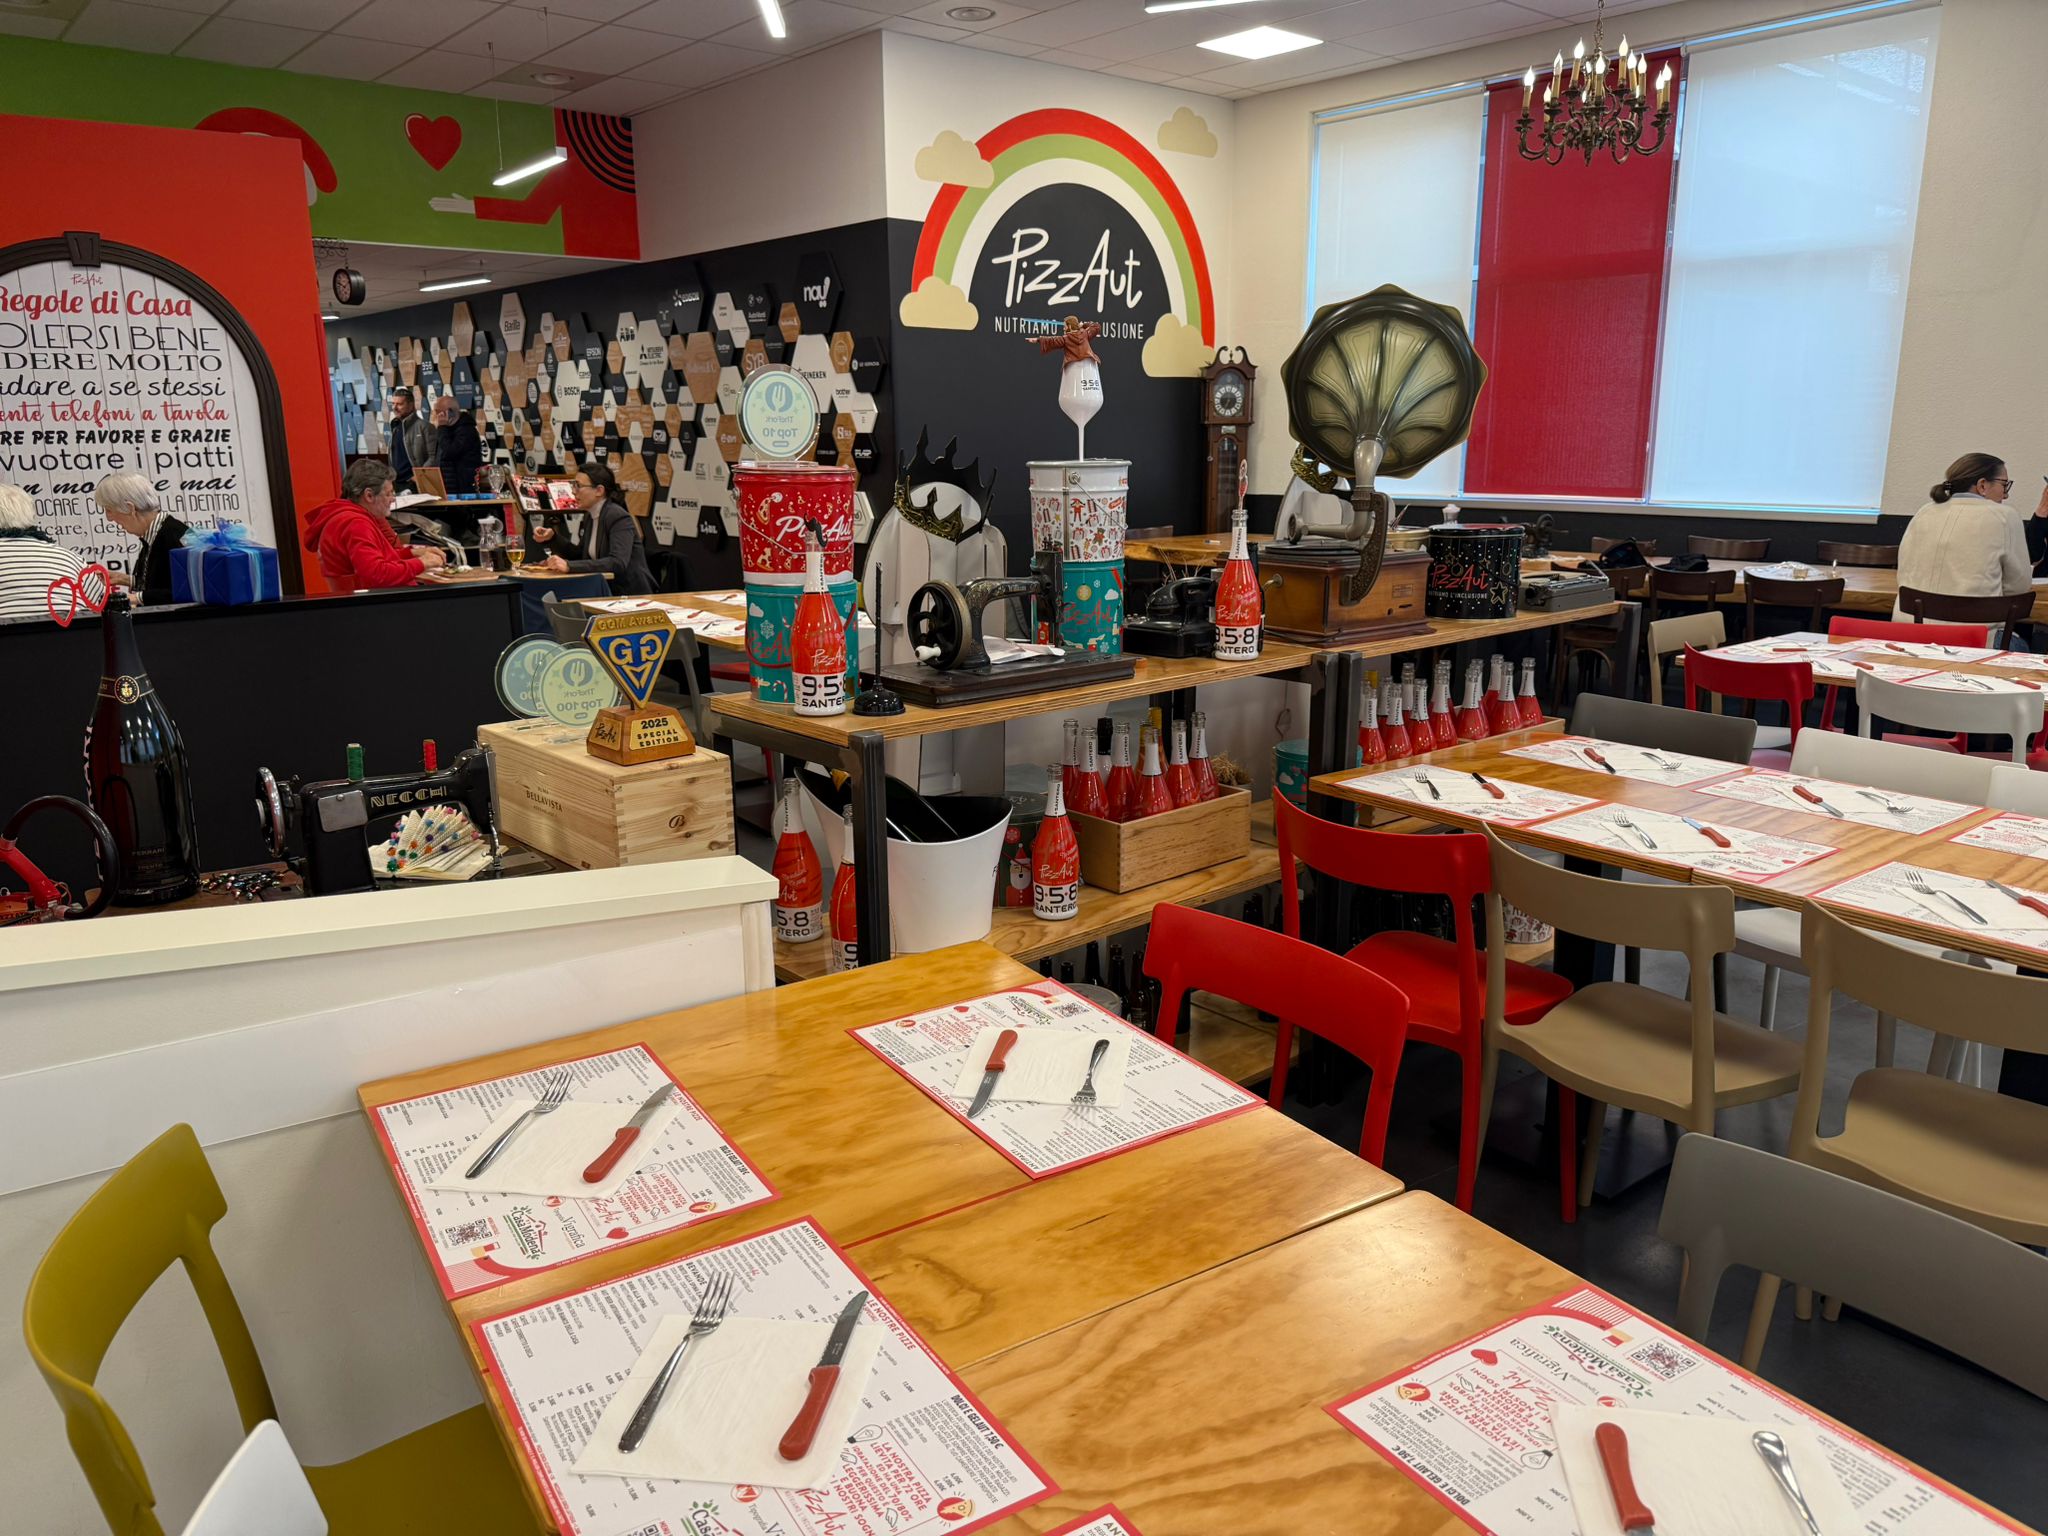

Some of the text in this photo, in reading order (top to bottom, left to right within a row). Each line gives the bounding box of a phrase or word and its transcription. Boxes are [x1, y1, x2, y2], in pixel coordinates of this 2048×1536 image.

[992, 228, 1142, 313] PizzAut
[92, 290, 120, 314] di
[126, 290, 192, 316] Casa
[131, 326, 220, 351] BENE
[108, 354, 222, 371] MOLTO
[83, 381, 102, 396] a
[109, 380, 141, 396] se
[148, 377, 226, 396] stessi
[564, 386, 580, 396] BOSCH
[48, 399, 134, 428] telefoni
[141, 410, 156, 421] a
[161, 398, 229, 421] tavola
[32, 430, 68, 445] PER
[76, 430, 145, 444] FAVORE
[151, 430, 161, 443] E
[168, 429, 231, 443] GRAZIE
[136, 447, 142, 468] i
[155, 446, 234, 474] piatti
[181, 475, 236, 491] mai
[189, 493, 240, 511] DENTRO
[1431, 563, 1489, 590] PizzAut
[637, 729, 678, 740] SPECIAL
[641, 717, 669, 730] 2025
[640, 735, 679, 747] EDITION
[370, 785, 447, 808] NECCHI
[526, 789, 563, 813] BELLAVISTA
[1039, 863, 1073, 879] PizzAut
[511, 1209, 543, 1254] Casa Modena
[560, 1216, 585, 1249] Vigrafica
[800, 1226, 827, 1250] ANTIPASTI
[686, 1262, 707, 1285] BEVANDE
[874, 1308, 900, 1332] NOSTRE
[896, 1332, 916, 1350] PIZZE
[1510, 1339, 1574, 1380] Vigrafica
[1552, 1332, 1644, 1390] Casa Modena
[1470, 1368, 1500, 1388] SOGNI
[1439, 1396, 1465, 1415] PIZZA
[1440, 1391, 1459, 1404] ORE
[1472, 1385, 1539, 1429] LEGGERISSIMA
[1480, 1403, 1494, 1414] DEL
[1489, 1390, 1527, 1412] BUONA
[1499, 1388, 1535, 1411] NOSTRI
[951, 1394, 969, 1410] DOLCI
[967, 1413, 989, 1432] GELAUT
[984, 1431, 1000, 1444] 7,50
[1471, 1413, 1490, 1425] PER
[1481, 1397, 1525, 1428] PER QUESTO
[1464, 1415, 1503, 1441] NOSTRA
[1485, 1426, 1526, 1451] LIEVITA
[852, 1446, 912, 1521] IDRATAZIONE DEL 70/80%
[856, 1466, 885, 1501] PER QUESTO
[870, 1442, 927, 1510] LIEVITA PER 72 ORE
[890, 1452, 915, 1481] NOSTRA
[912, 1482, 932, 1503] PIZZA
[890, 1482, 902, 1495] UNA
[834, 1485, 858, 1513] NOSTRI
[843, 1464, 887, 1516] LEGGERISSIMA
[844, 1483, 867, 1510] BUONA
